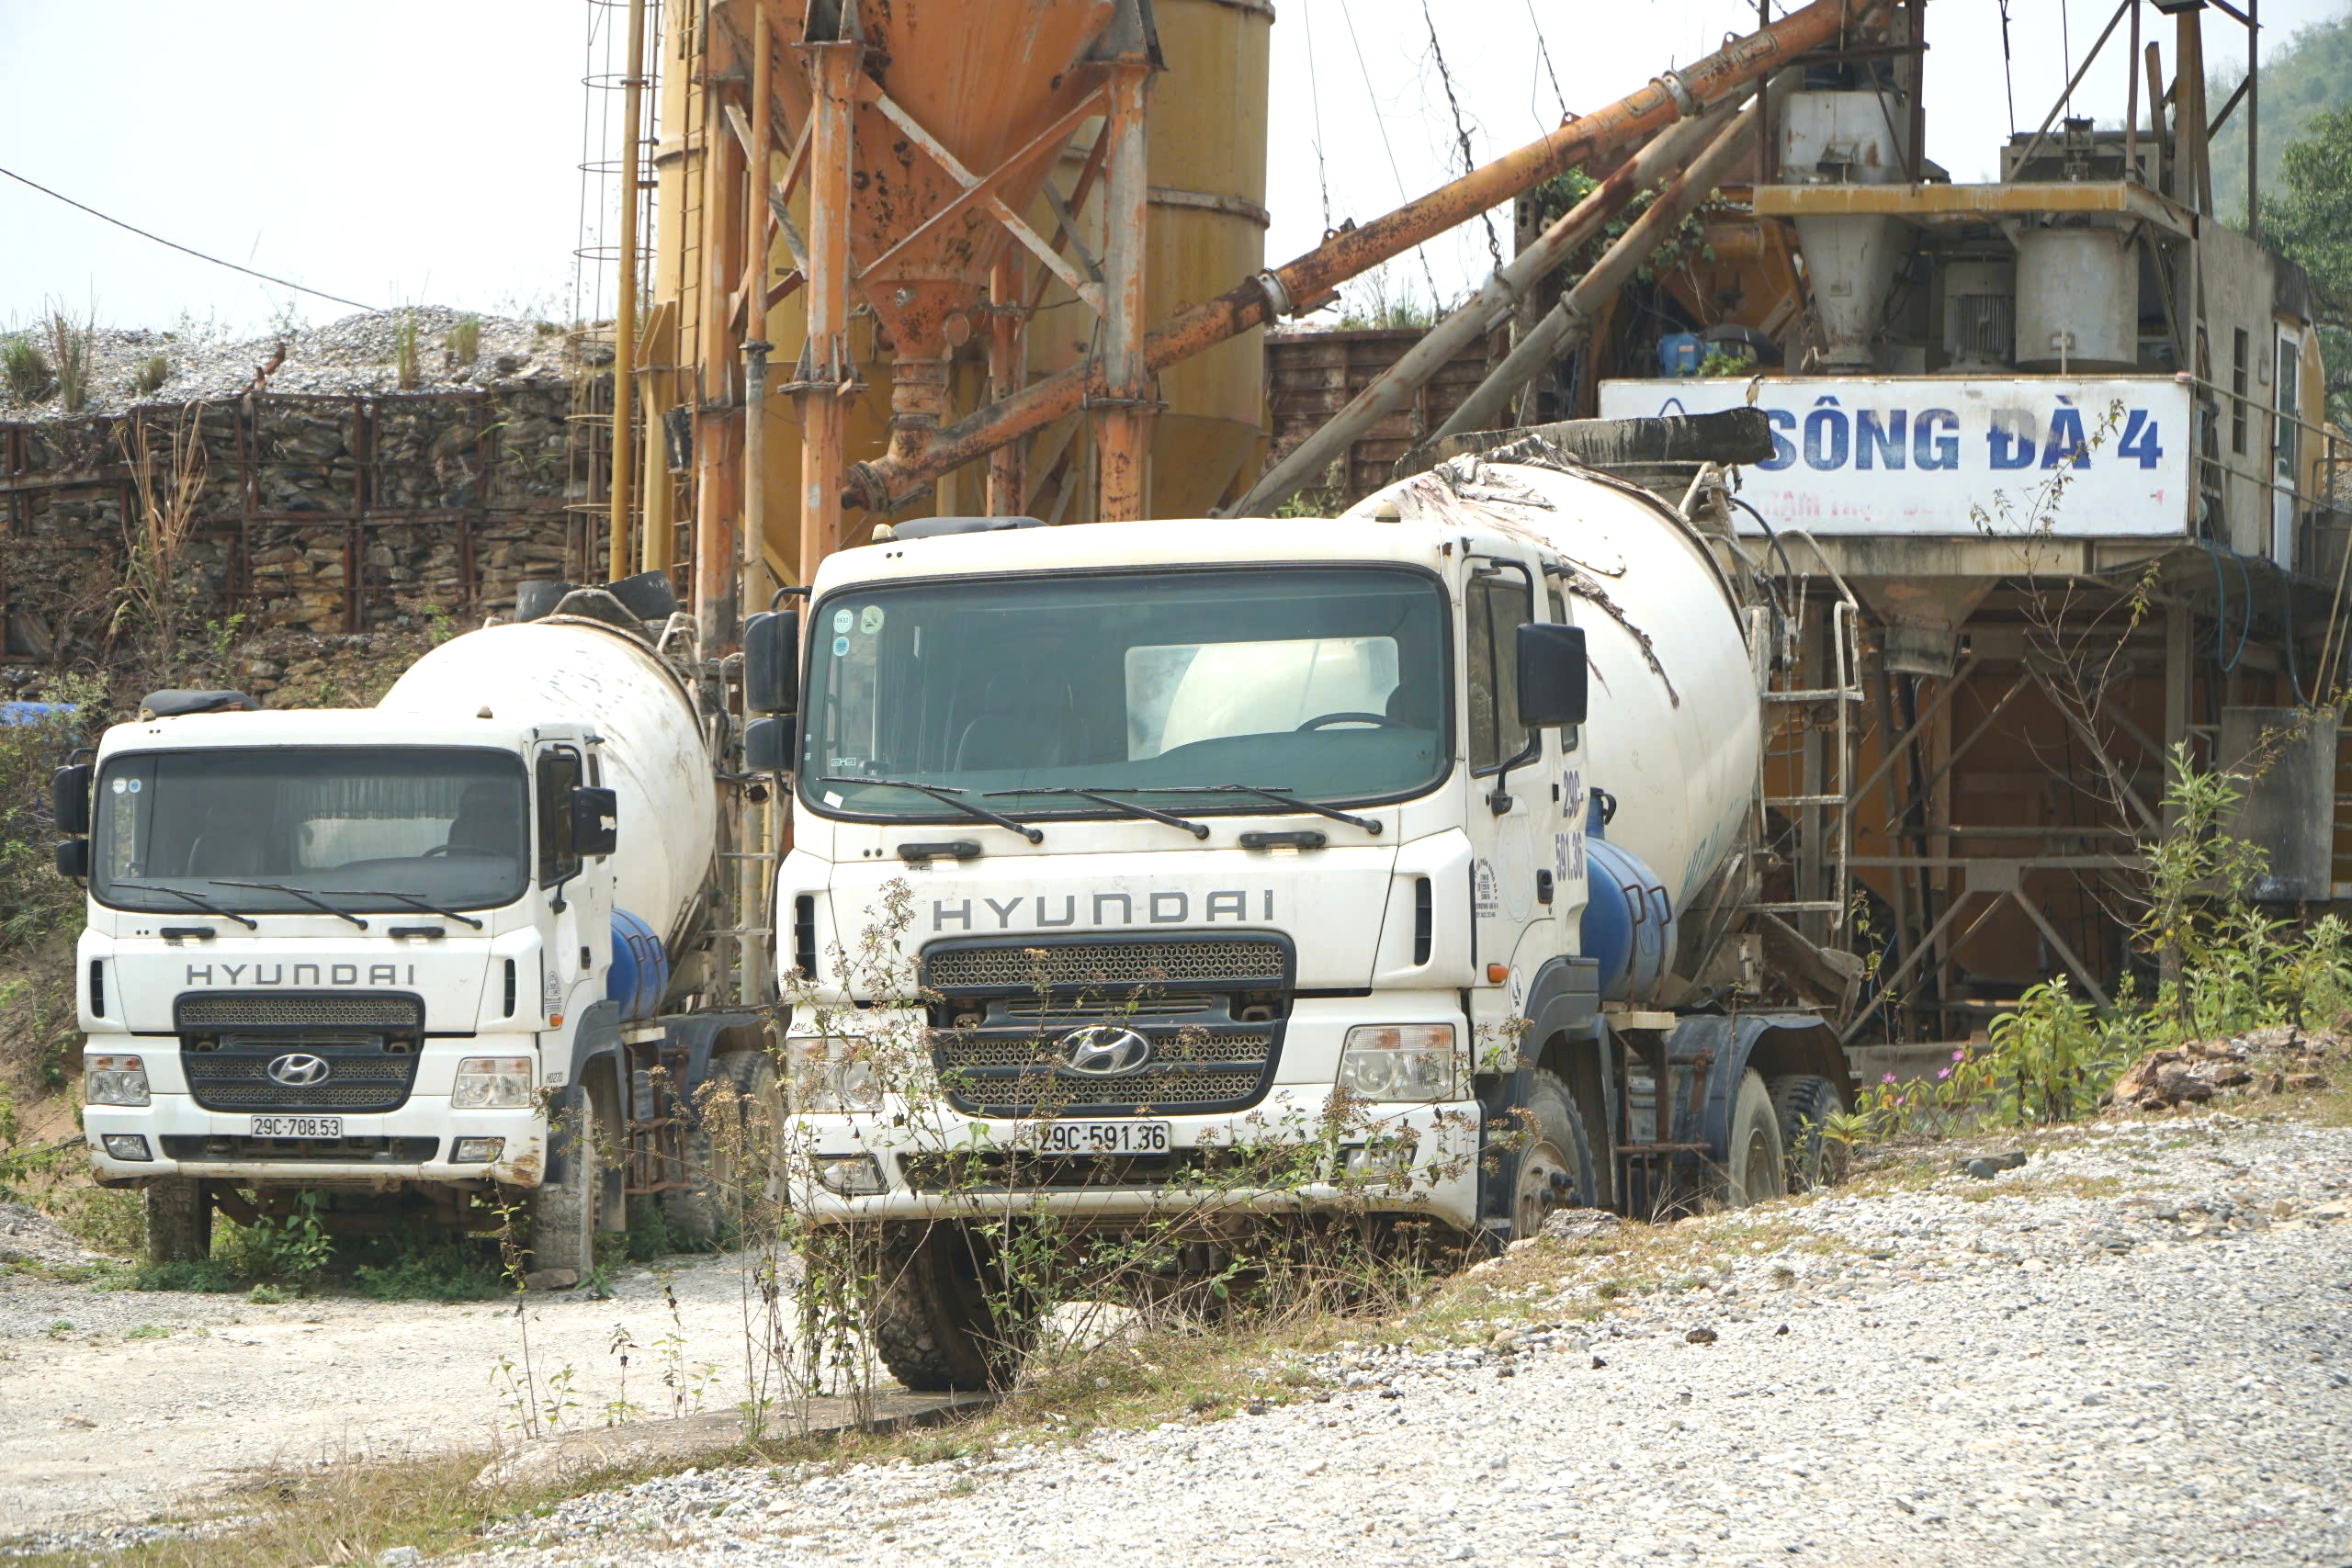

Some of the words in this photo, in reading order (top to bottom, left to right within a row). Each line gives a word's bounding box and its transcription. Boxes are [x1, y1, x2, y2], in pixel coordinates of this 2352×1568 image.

[1754, 396, 1959, 471] SÔNG
[1986, 394, 2091, 469] ĐÀ
[2118, 409, 2163, 469] 4
[1555, 831, 1583, 882] 591.36
[933, 890, 1273, 931] HYUNDAI
[187, 964, 414, 986] HYUNDAI
[254, 1118, 339, 1135] 29C-708.53
[1039, 1124, 1166, 1152] 29C-591.36
